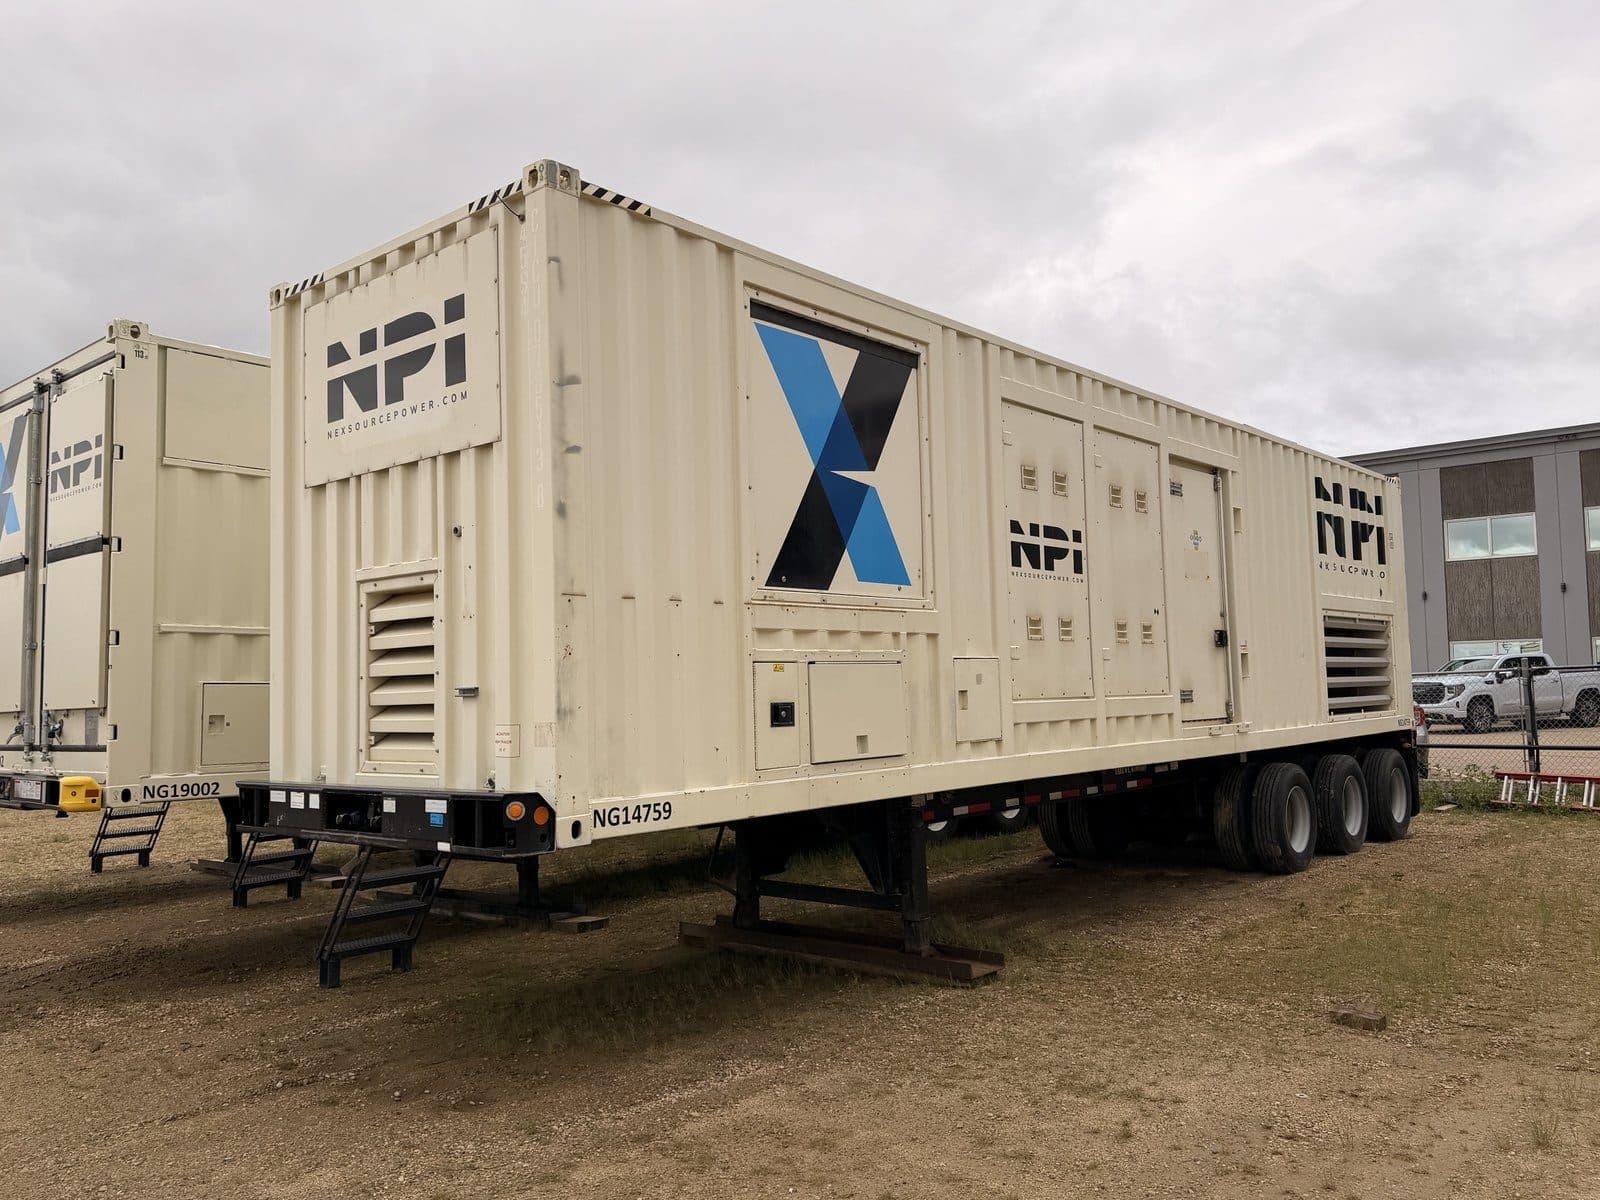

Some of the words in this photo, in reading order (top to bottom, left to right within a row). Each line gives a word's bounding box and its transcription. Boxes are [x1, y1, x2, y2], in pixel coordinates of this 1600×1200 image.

[327, 293, 467, 424] NPI
[327, 390, 468, 440] NEXSOURCEPOWER.COM
[51, 433, 103, 495] NPI
[1009, 519, 1083, 575] NPI
[143, 782, 220, 799] NG19002
[593, 801, 673, 829] NG14759
